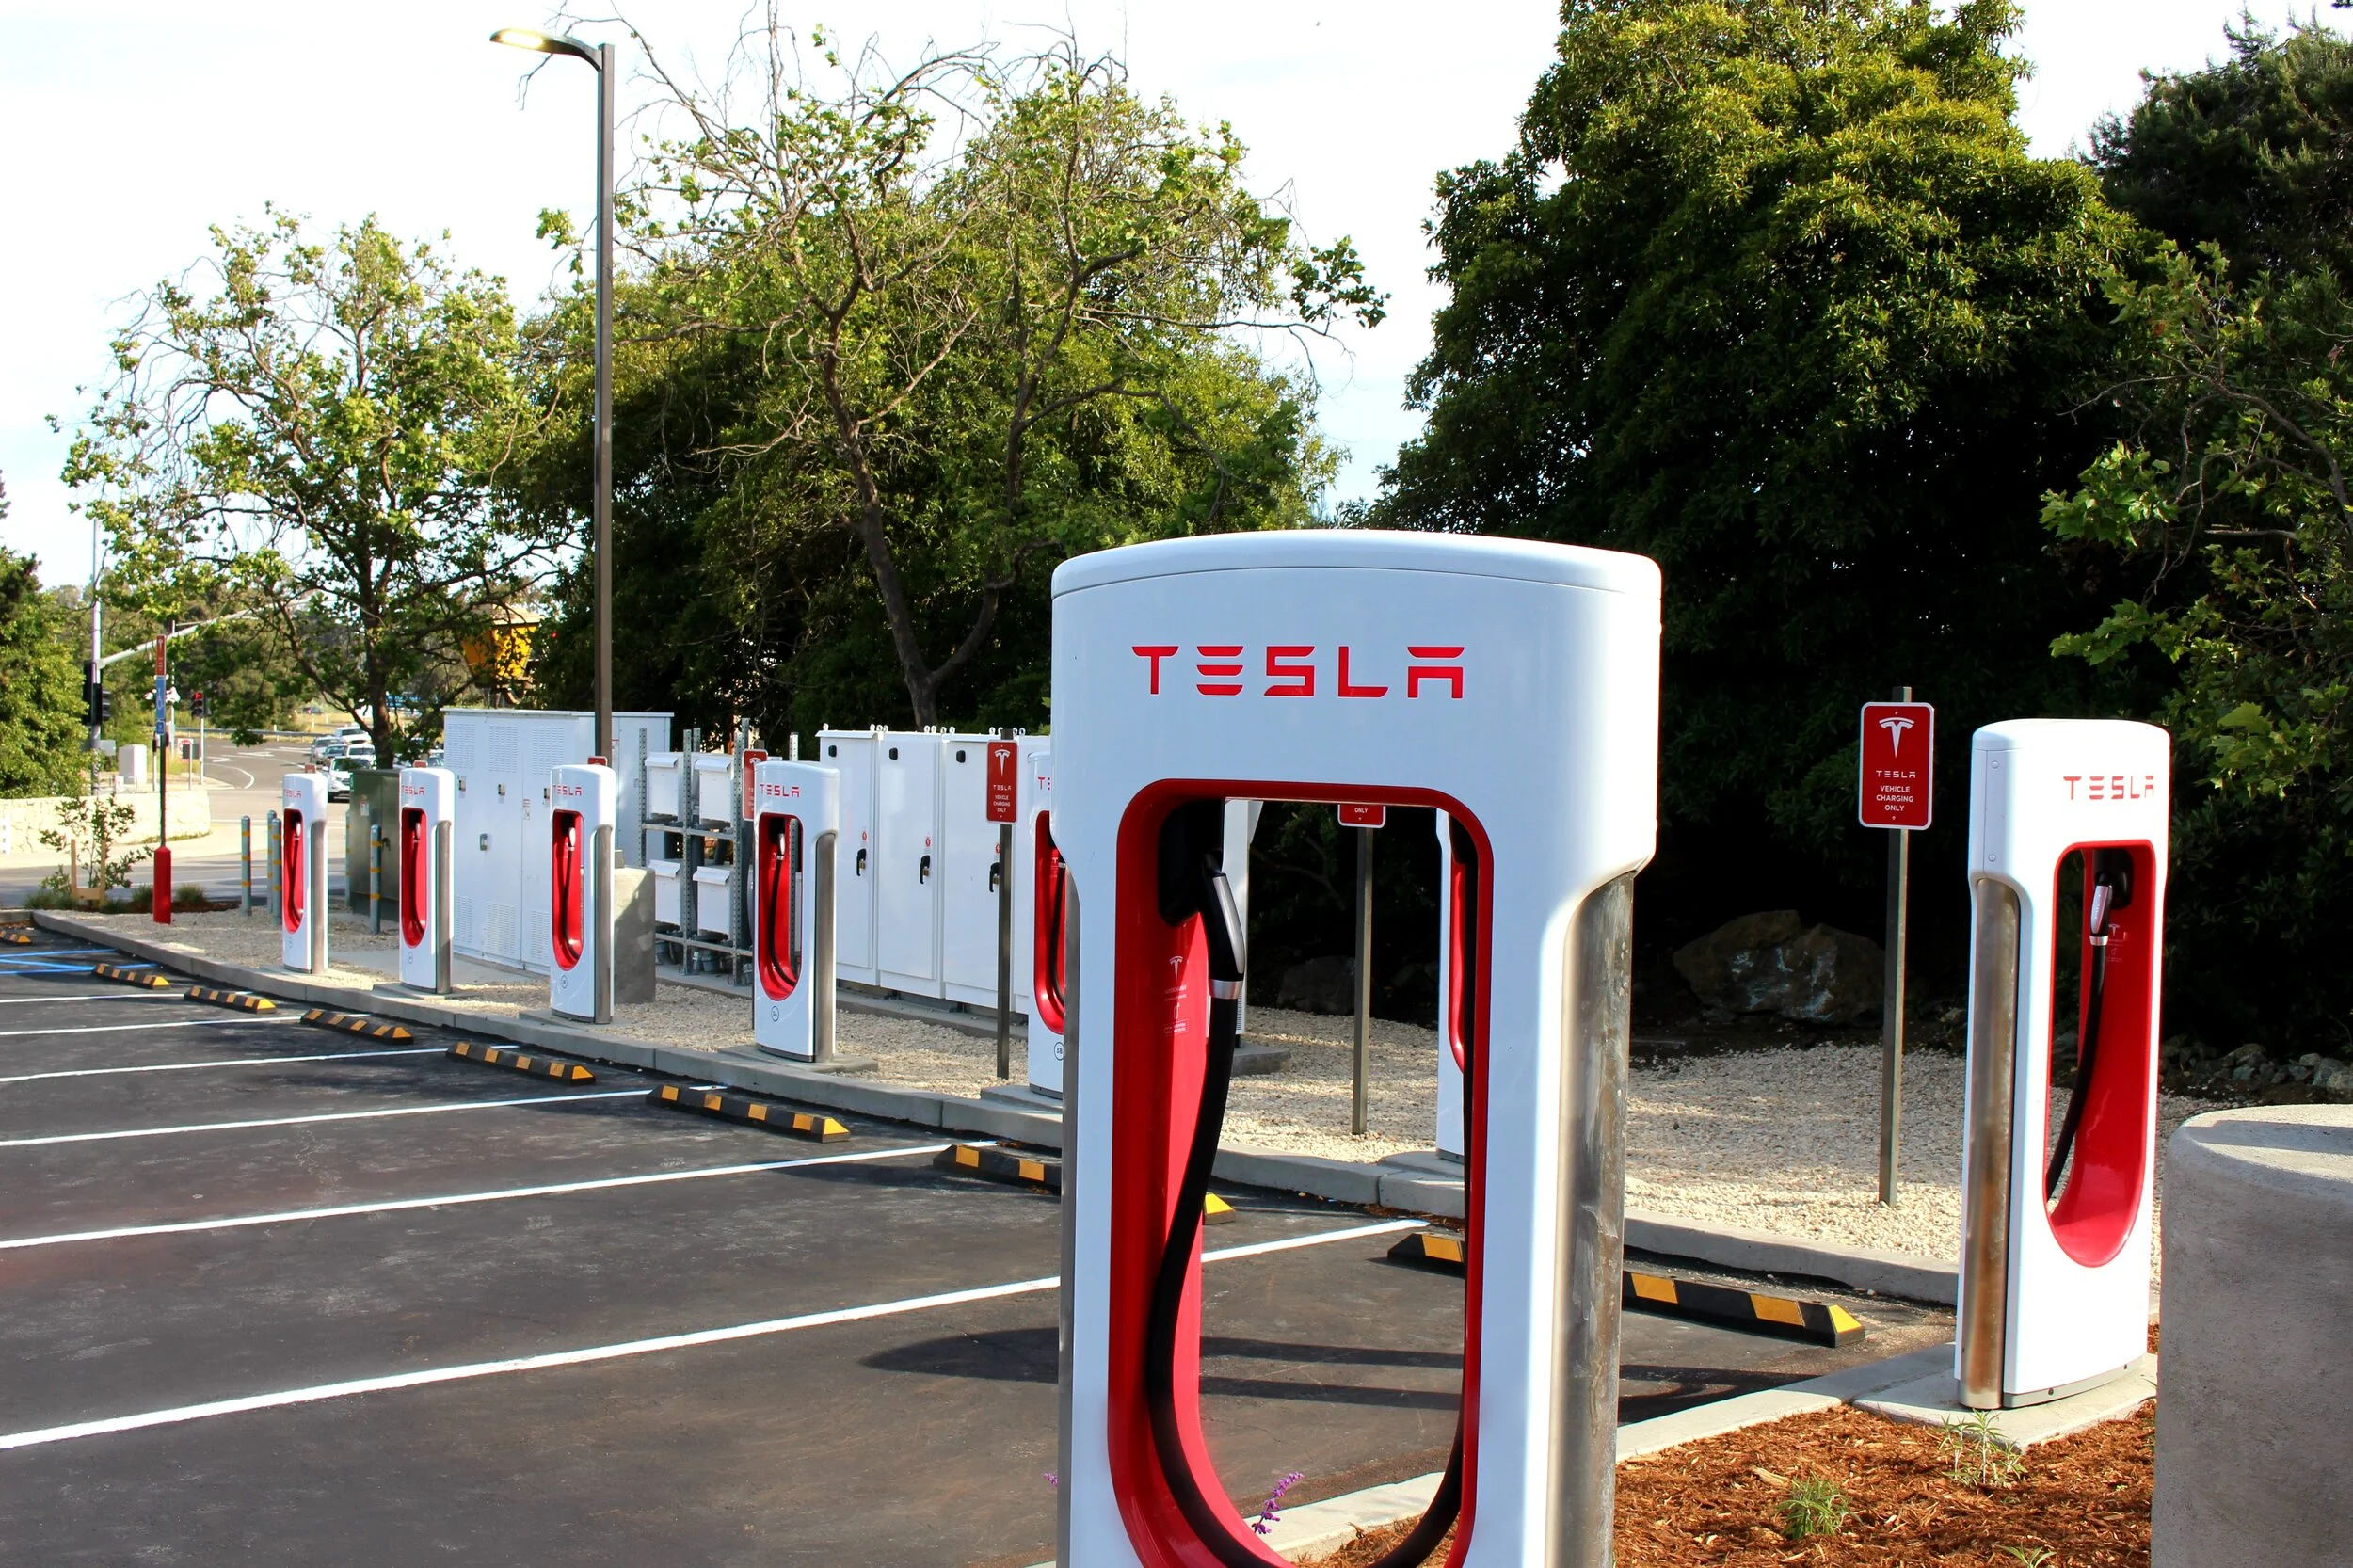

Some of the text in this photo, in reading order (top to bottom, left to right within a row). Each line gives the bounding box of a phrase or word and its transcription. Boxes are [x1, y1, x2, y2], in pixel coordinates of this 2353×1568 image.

[1131, 645, 1465, 699] TESLA
[1875, 770, 1916, 778] TESLA
[552, 784, 582, 796] TESLA
[760, 784, 800, 798] TESLA
[2063, 775, 2154, 800] TESLA
[1876, 794, 1914, 803] CHARGING
